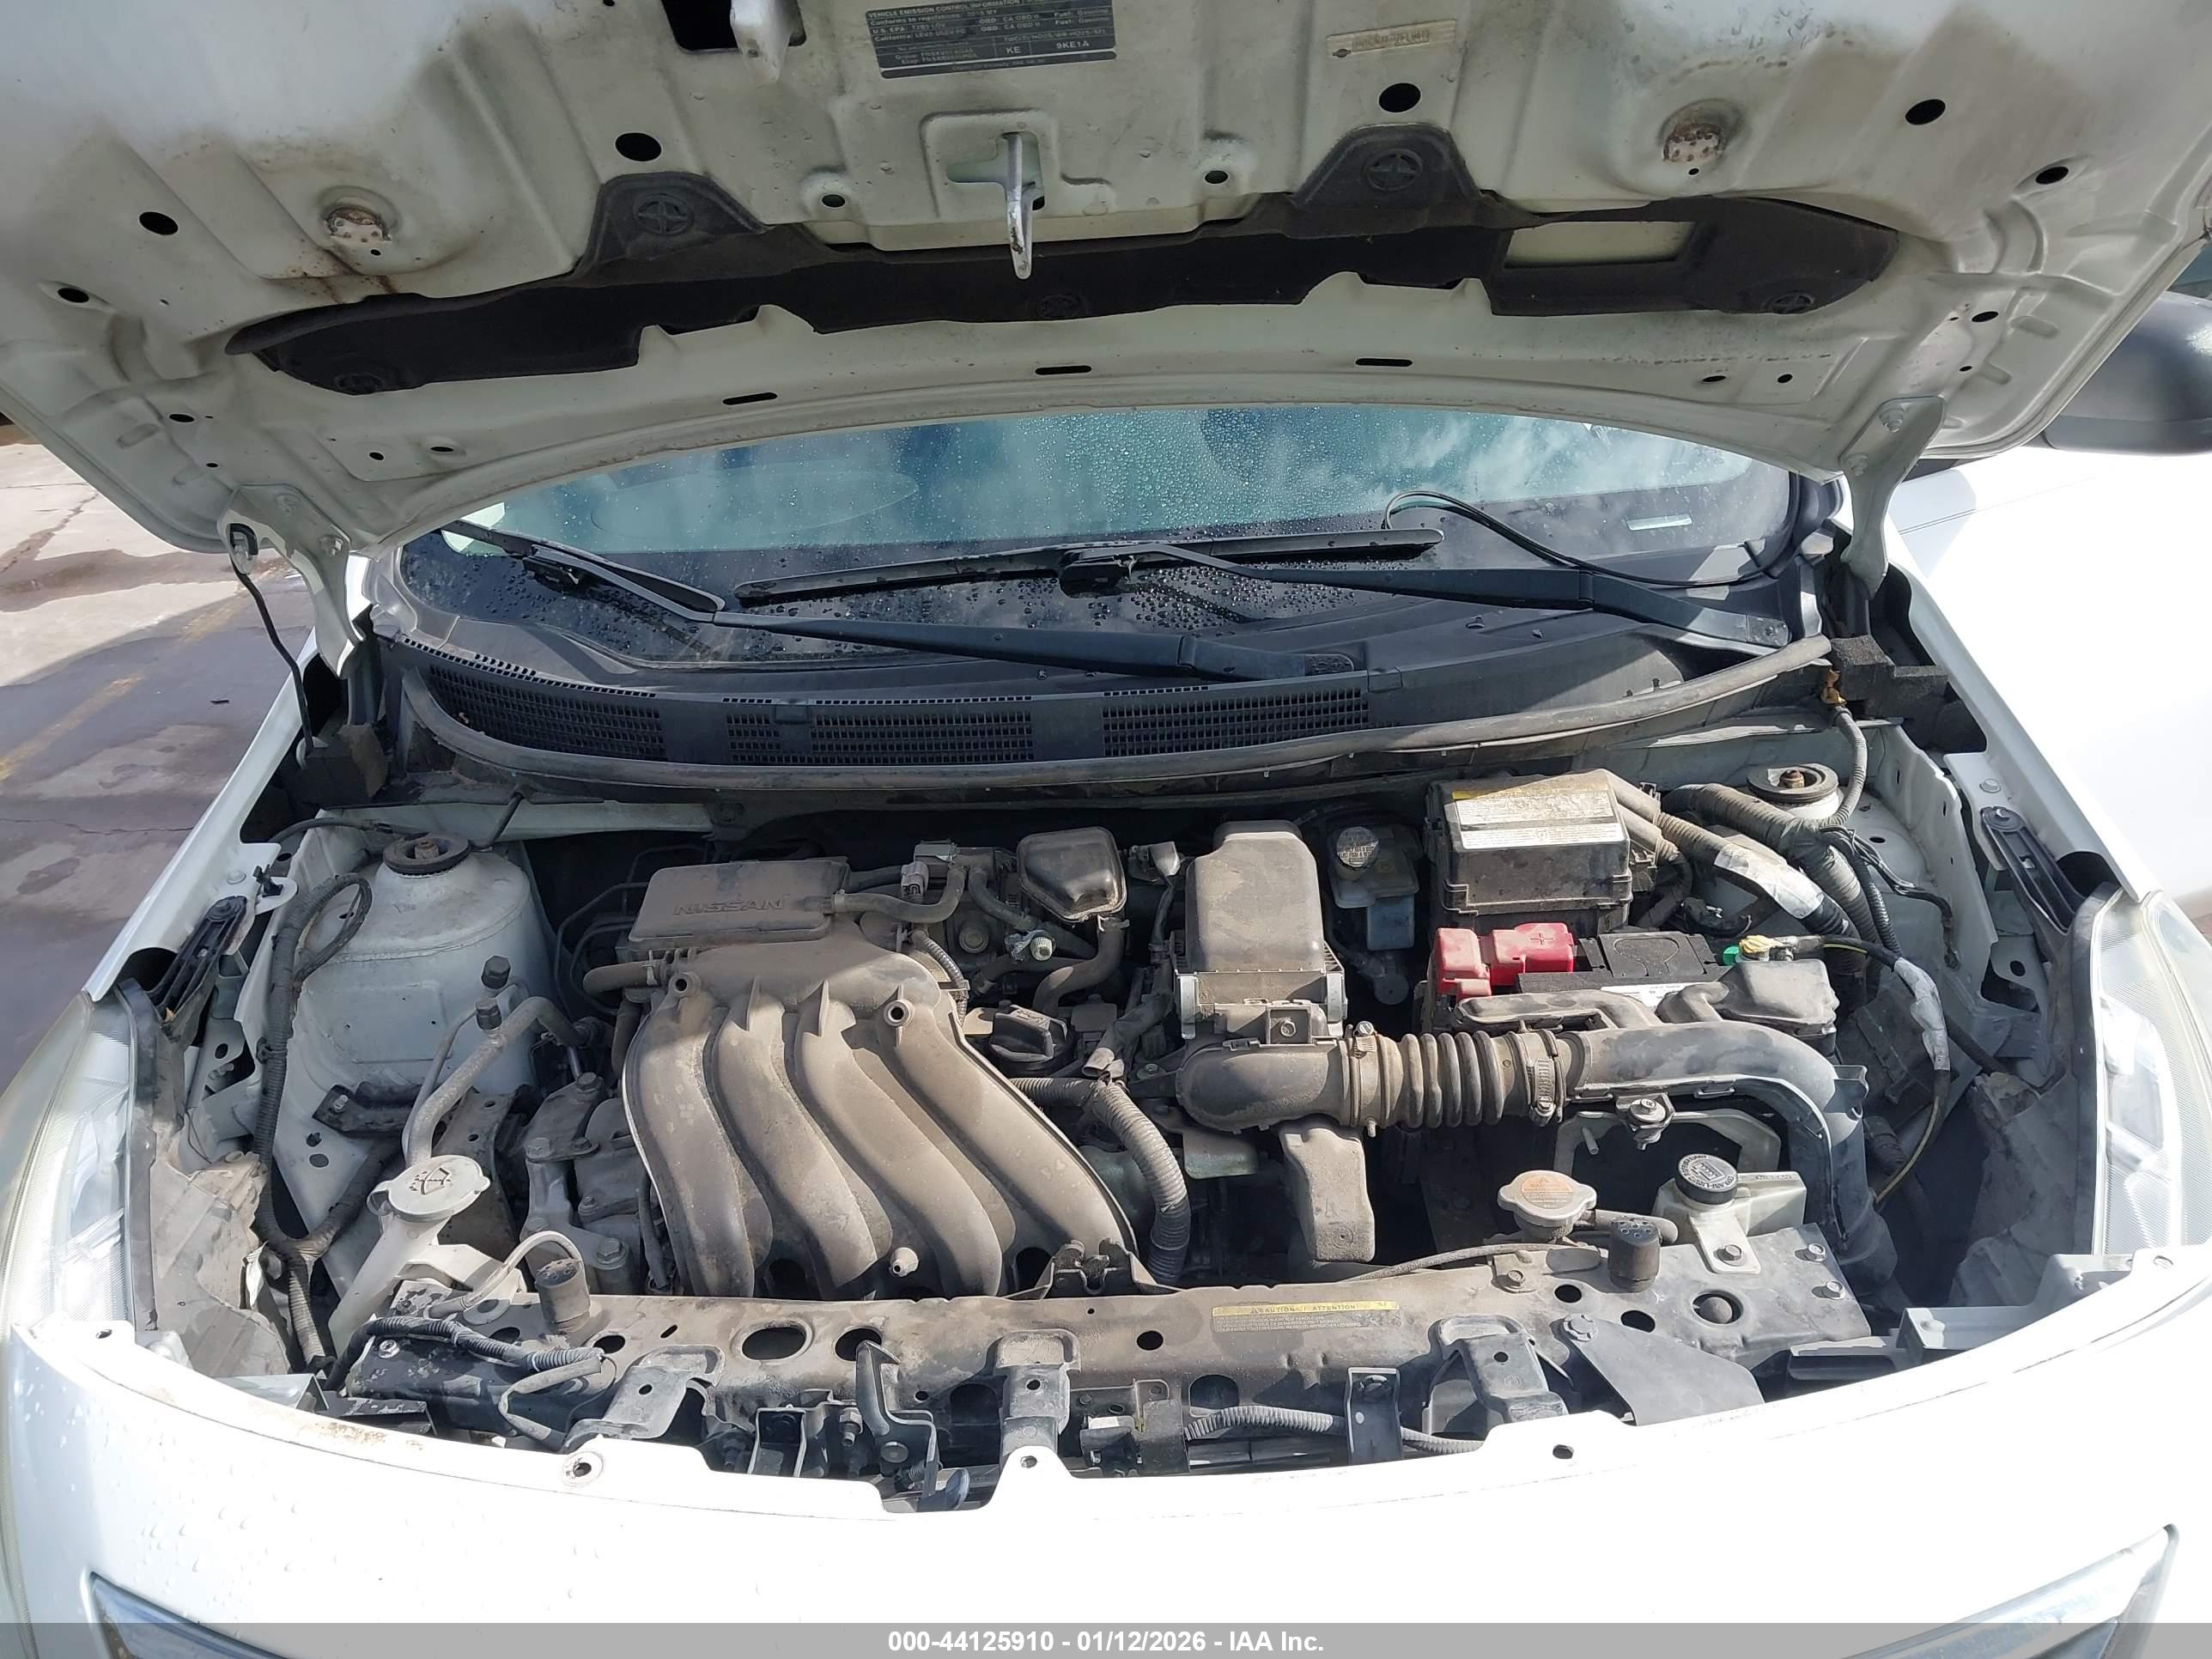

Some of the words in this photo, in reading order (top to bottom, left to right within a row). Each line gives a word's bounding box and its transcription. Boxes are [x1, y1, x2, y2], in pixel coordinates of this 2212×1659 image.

[1056, 40, 1090, 49] 9KE1A
[673, 898, 782, 916] NISSAN
[1312, 1304, 1356, 1312] ATTENTION
